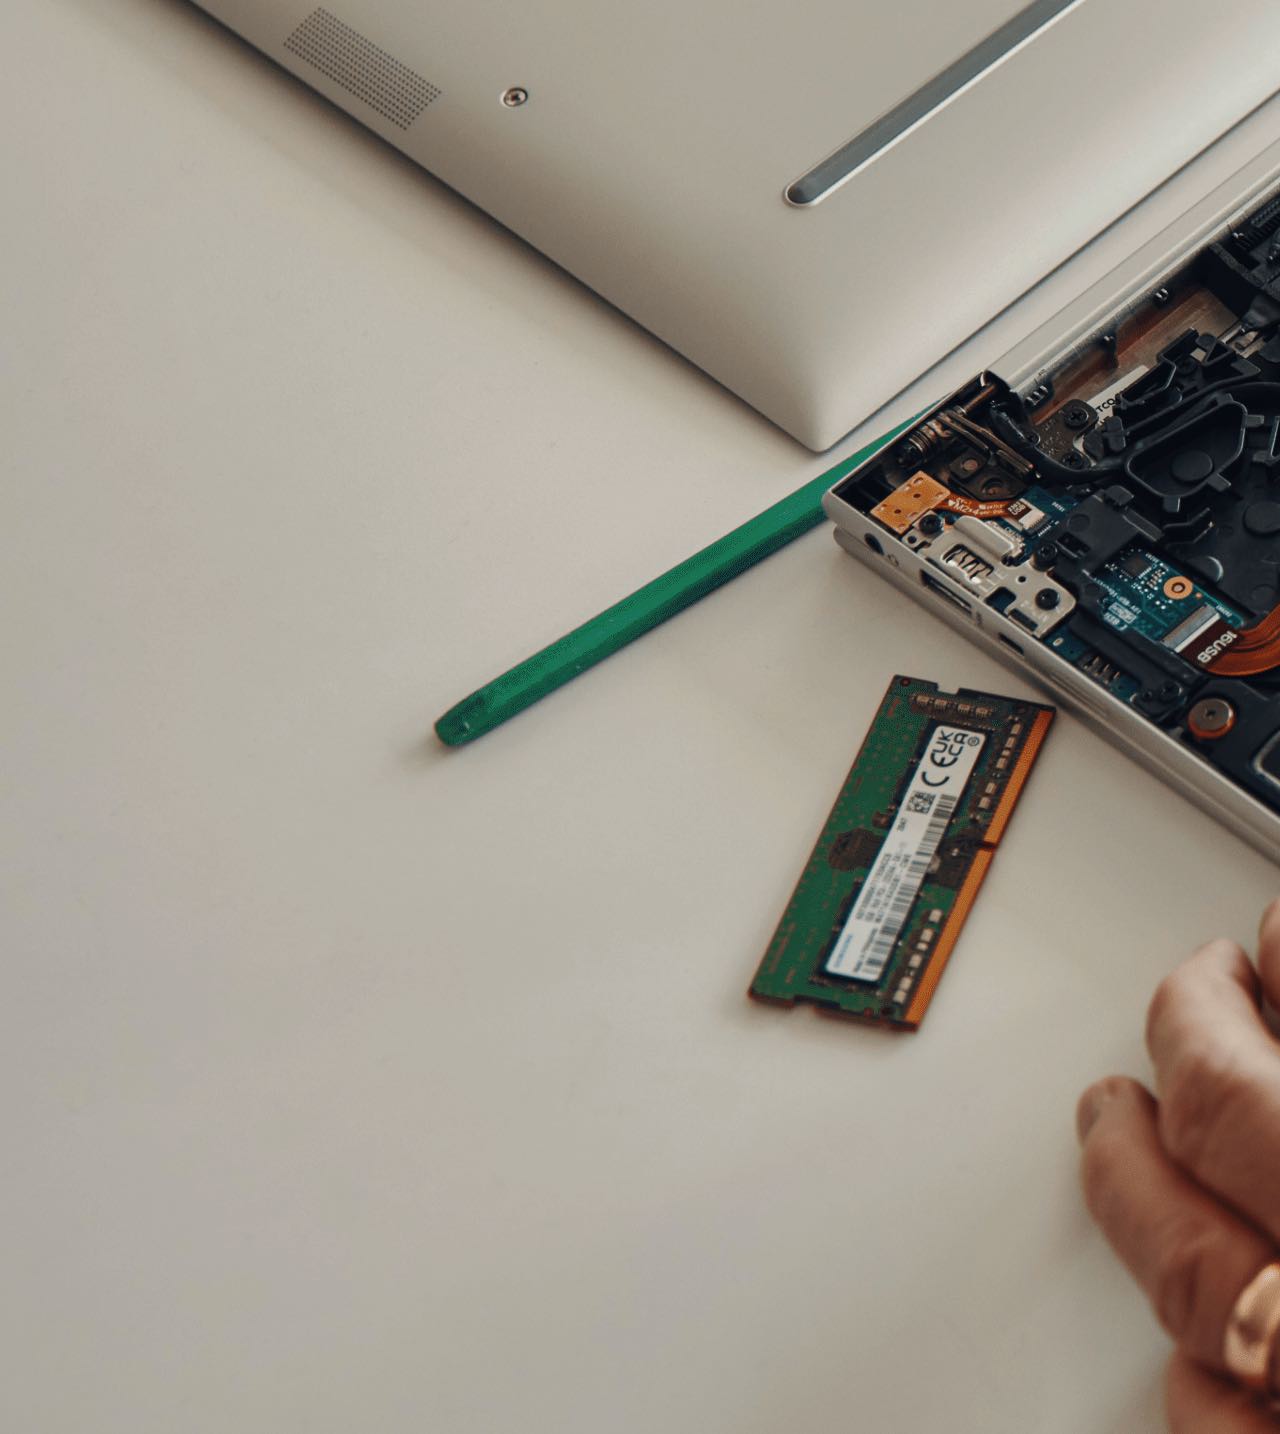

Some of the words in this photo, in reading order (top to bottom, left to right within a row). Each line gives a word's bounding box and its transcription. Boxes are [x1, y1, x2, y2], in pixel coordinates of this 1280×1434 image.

[1196, 629, 1237, 664] 16USB
[931, 728, 955, 754] UK
[947, 732, 969, 757] CA
